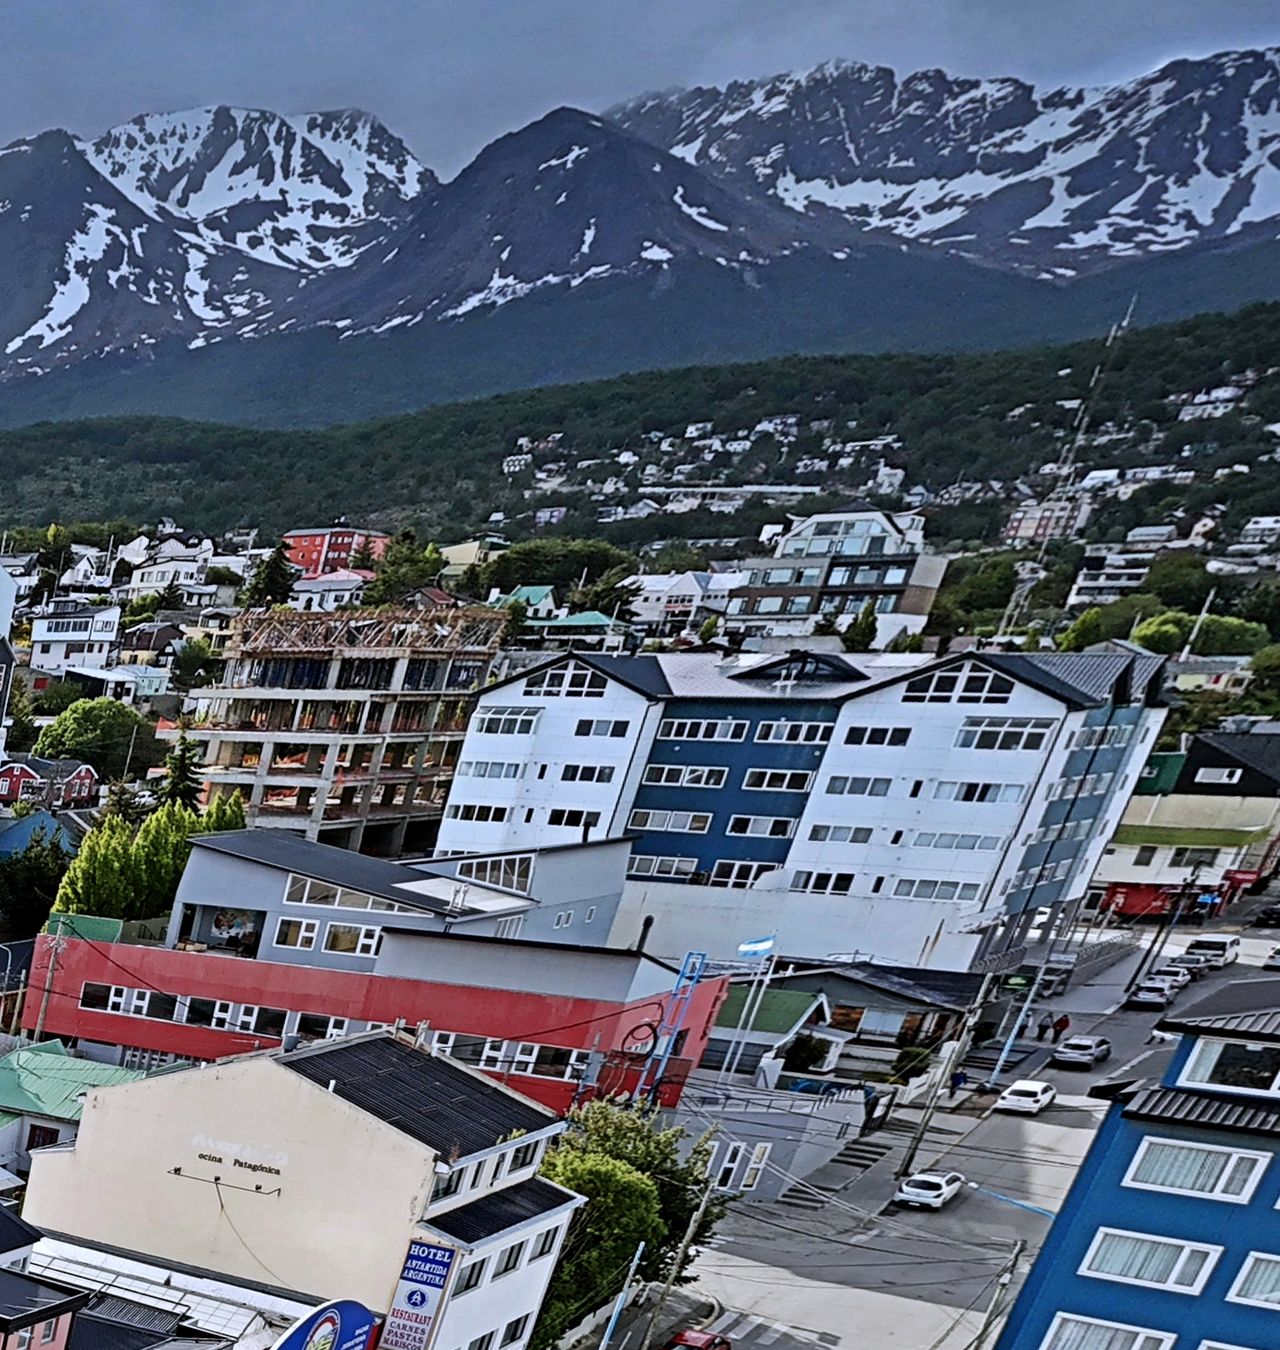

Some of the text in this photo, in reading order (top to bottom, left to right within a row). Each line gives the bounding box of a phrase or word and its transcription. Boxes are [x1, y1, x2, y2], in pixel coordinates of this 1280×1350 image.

[198, 1153, 281, 1175] ocina Patagónica
[410, 1244, 451, 1263] HOTEL
[402, 1269, 445, 1286] ARGENTINA
[390, 1307, 432, 1326] RESTAURANT
[387, 1328, 424, 1344] PASTAS
[389, 1320, 426, 1336] CARNES
